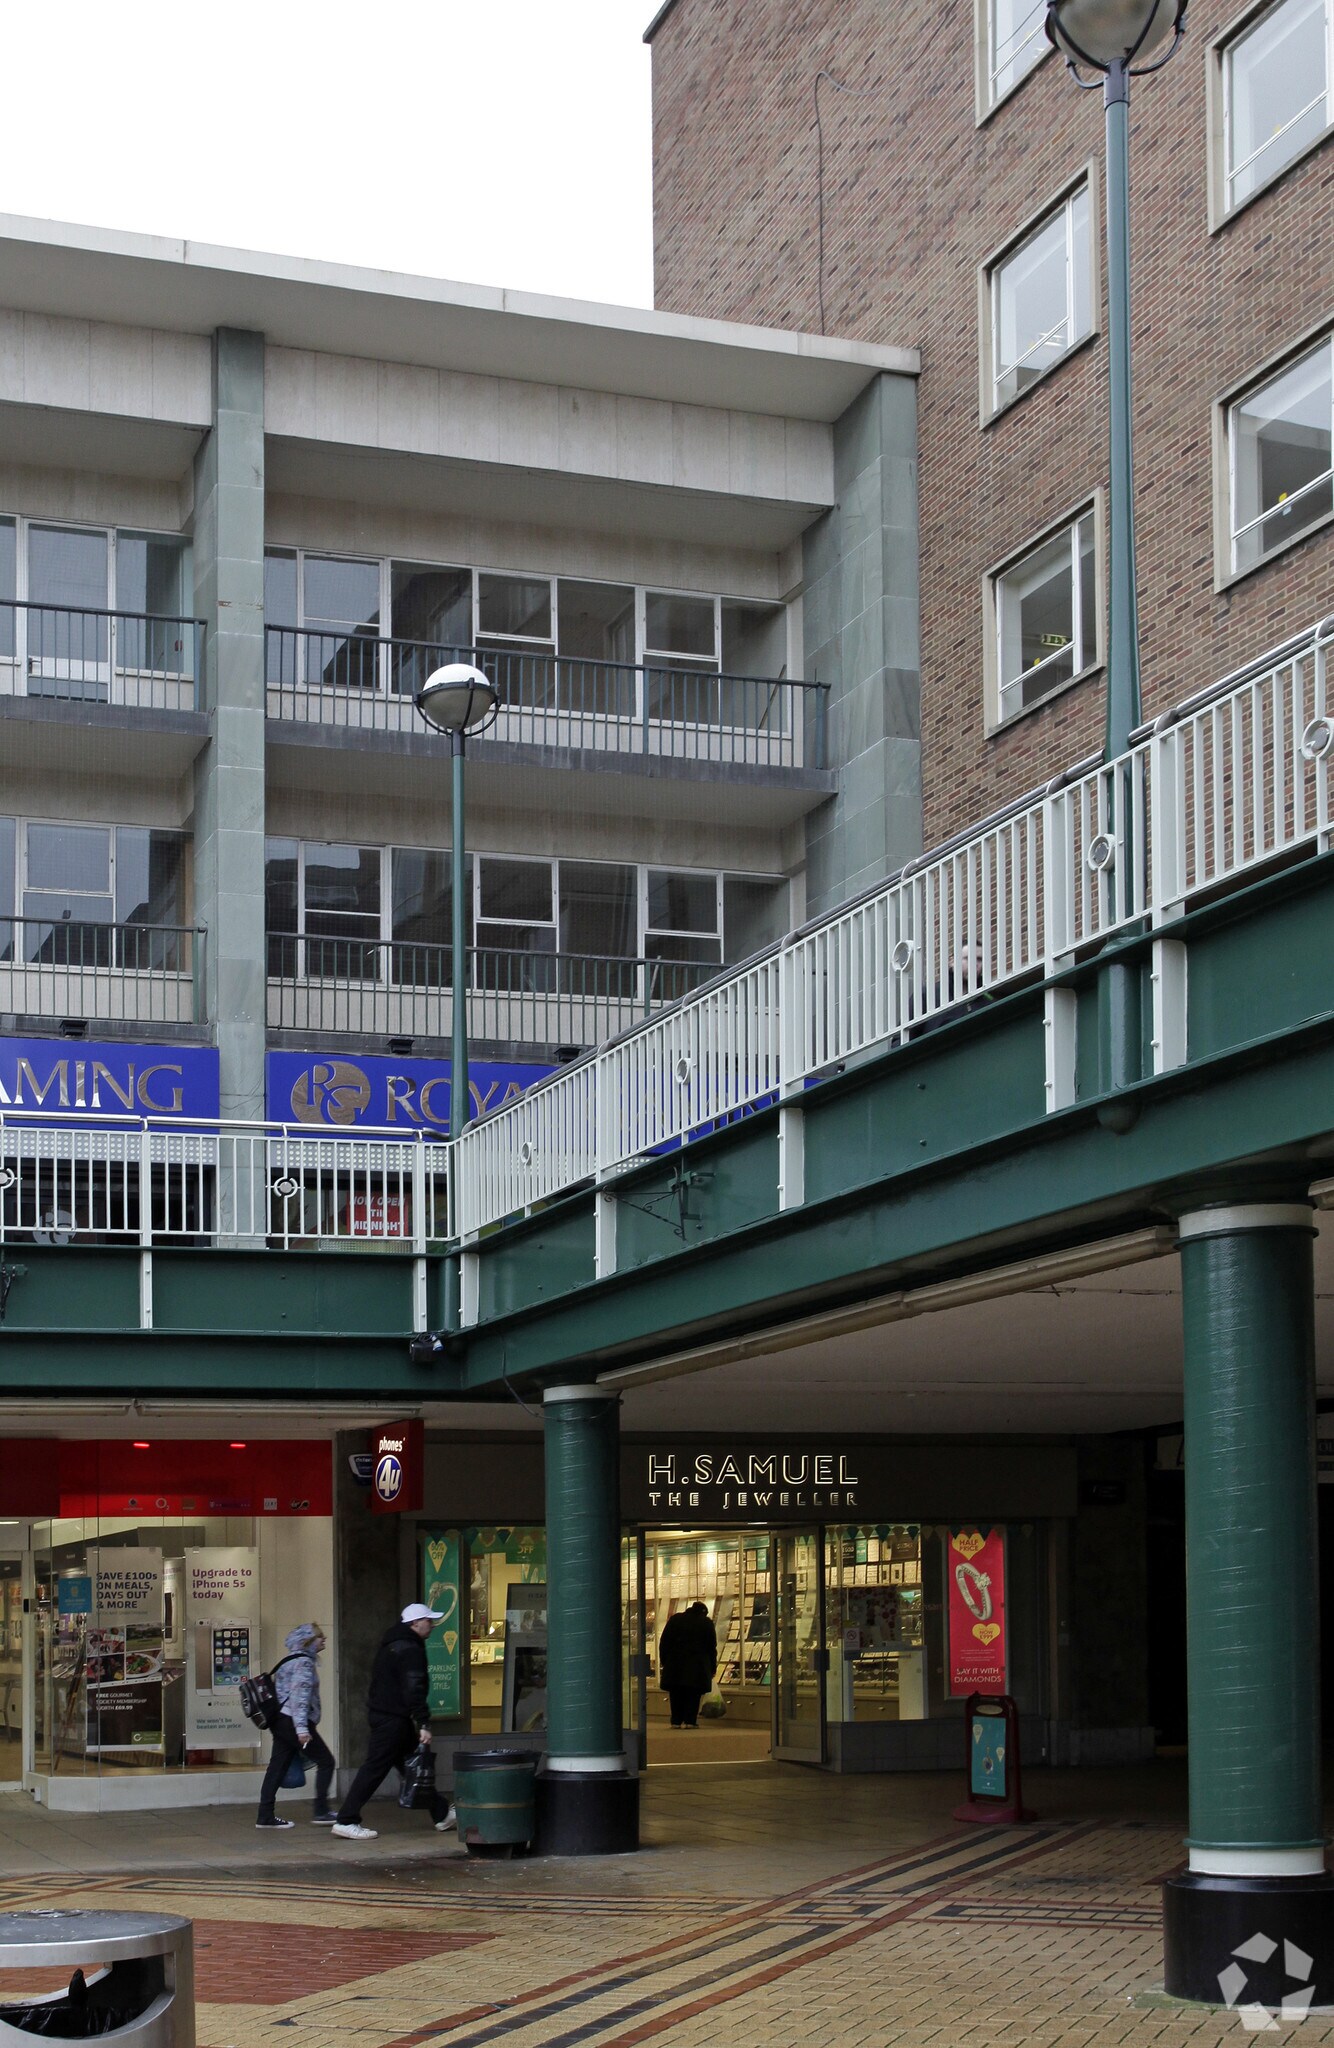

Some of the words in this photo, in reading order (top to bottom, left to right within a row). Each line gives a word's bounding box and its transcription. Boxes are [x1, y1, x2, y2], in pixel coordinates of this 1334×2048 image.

[378, 1436, 403, 1454] phones
[648, 1454, 858, 1485] H.SAMUEL
[378, 1459, 401, 1497] 4u
[648, 1492, 700, 1507] THE
[722, 1492, 858, 1510] JEWELLER
[431, 1551, 443, 1560] OFF
[96, 1572, 123, 1580] SAVE
[125, 1572, 158, 1580] £100s
[192, 1568, 238, 1579] Upgrade
[241, 1568, 252, 1577] to
[96, 1582, 112, 1590] ON
[114, 1581, 154, 1591] MEALS,
[192, 1580, 230, 1589] iPhone
[233, 1579, 246, 1588] 5s
[96, 1591, 124, 1599] DAYS
[126, 1591, 148, 1599] OUT
[192, 1590, 224, 1601] today
[96, 1601, 104, 1609] &
[107, 1600, 138, 1609] MORE
[427, 1664, 456, 1673] SPARKLING
[956, 1667, 971, 1675] SAY
[972, 1667, 978, 1675] IT
[431, 1673, 452, 1682] SPRING
[954, 1675, 1002, 1684] DIAMONDS
